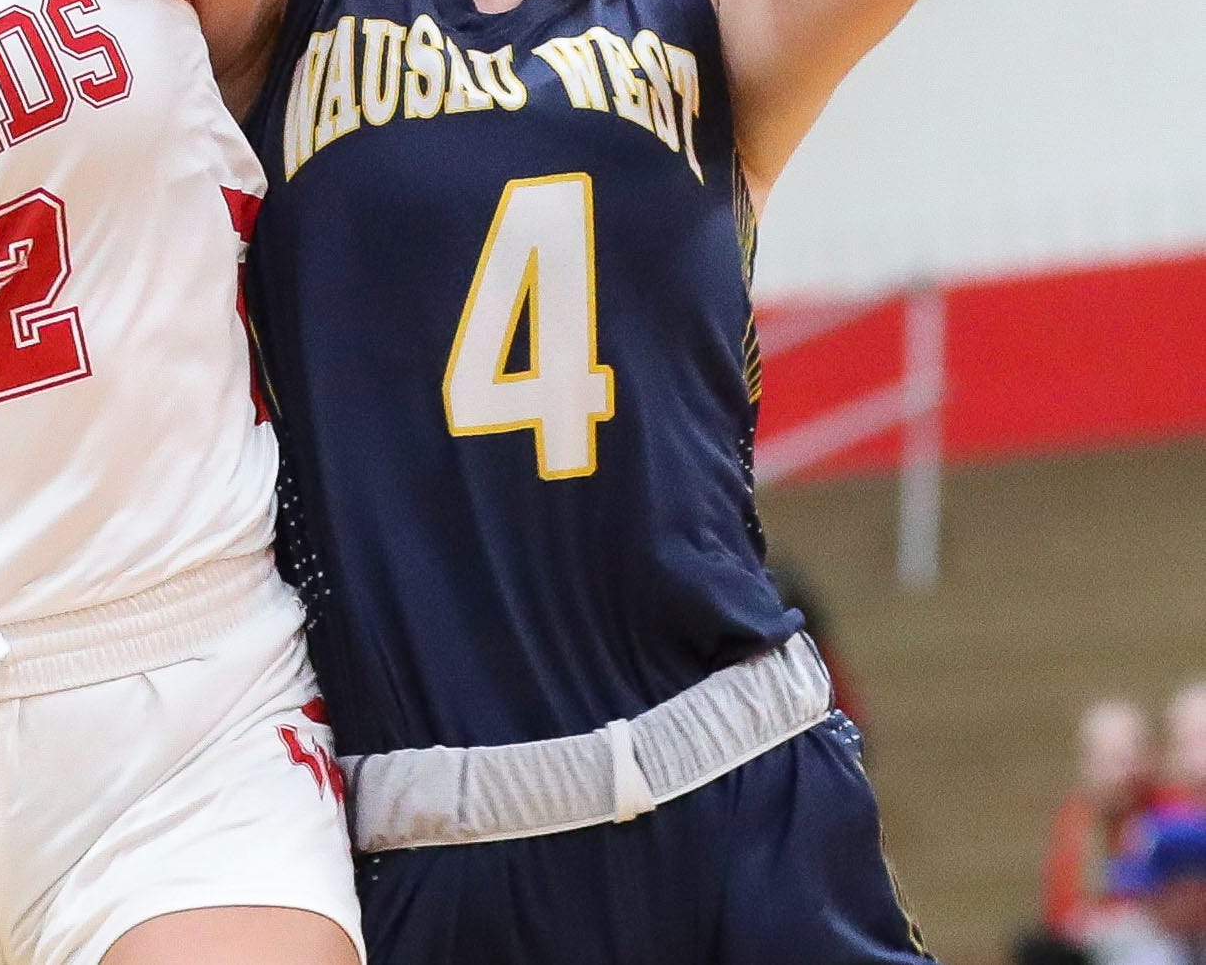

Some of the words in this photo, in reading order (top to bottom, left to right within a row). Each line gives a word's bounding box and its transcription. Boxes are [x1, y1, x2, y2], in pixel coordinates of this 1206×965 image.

[283, 13, 528, 182] WAUSAU
[531, 26, 705, 185] WEST
[442, 172, 615, 481] 4
